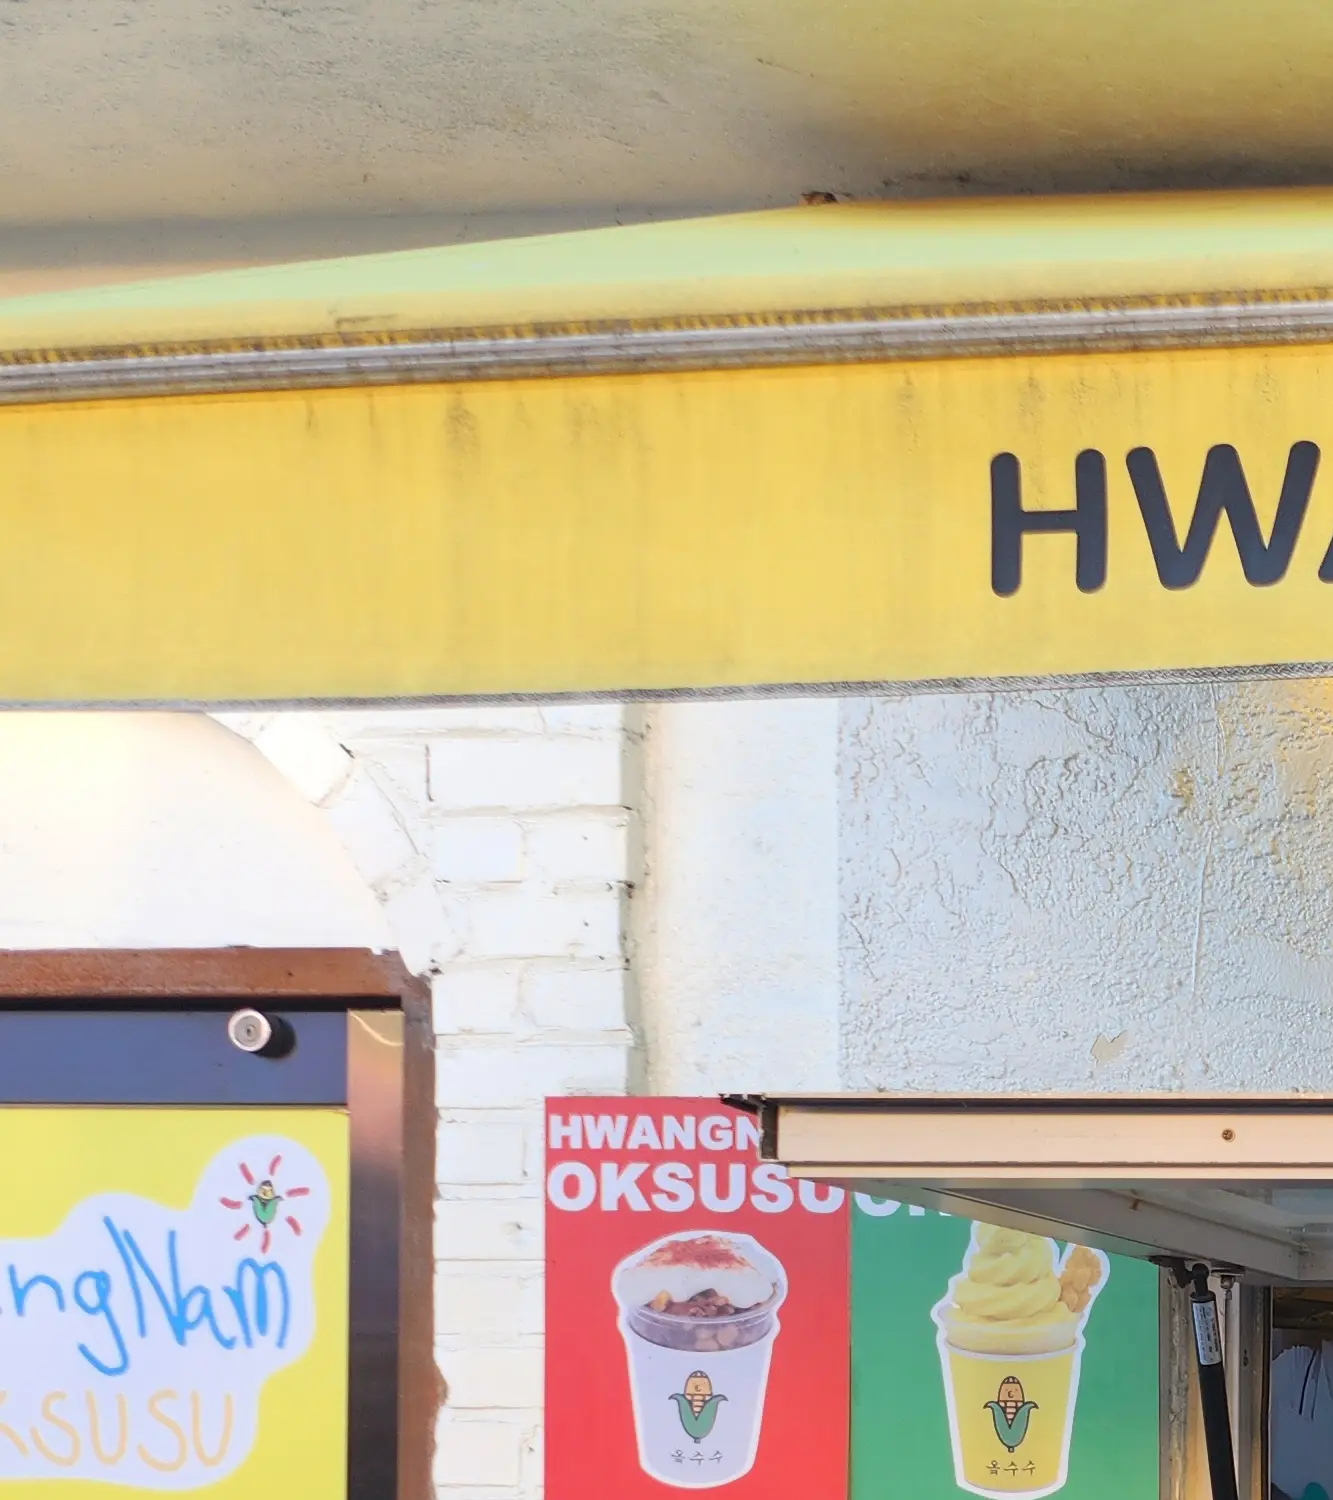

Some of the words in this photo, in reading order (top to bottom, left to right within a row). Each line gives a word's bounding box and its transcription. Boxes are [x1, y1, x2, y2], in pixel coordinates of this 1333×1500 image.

[548, 1113, 764, 1151] HWANGN
[0, 1216, 290, 1376] ngNam
[0, 1389, 233, 1471] SUSU
[986, 1459, 1037, 1476] 옥수수
